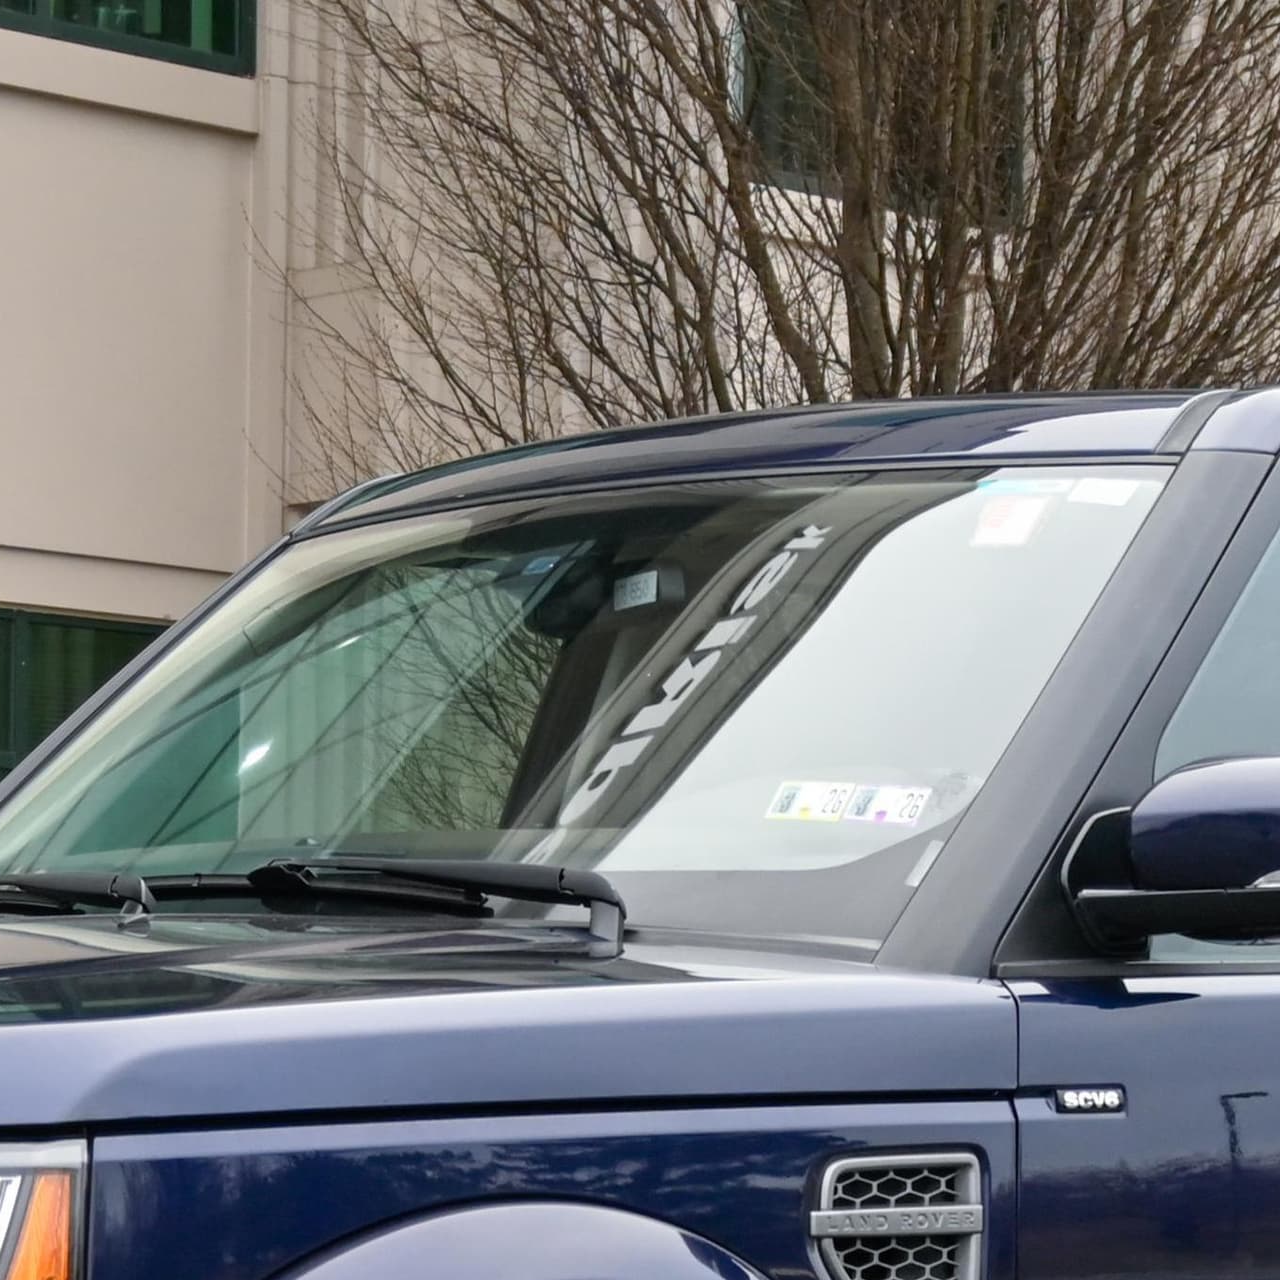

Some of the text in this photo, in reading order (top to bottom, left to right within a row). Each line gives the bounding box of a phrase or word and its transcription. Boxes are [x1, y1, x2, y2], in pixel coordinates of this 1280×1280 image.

[898, 792, 925, 819] 26
[1063, 1090, 1120, 1109] SCV6
[826, 1211, 975, 1232] LAND ROVER
